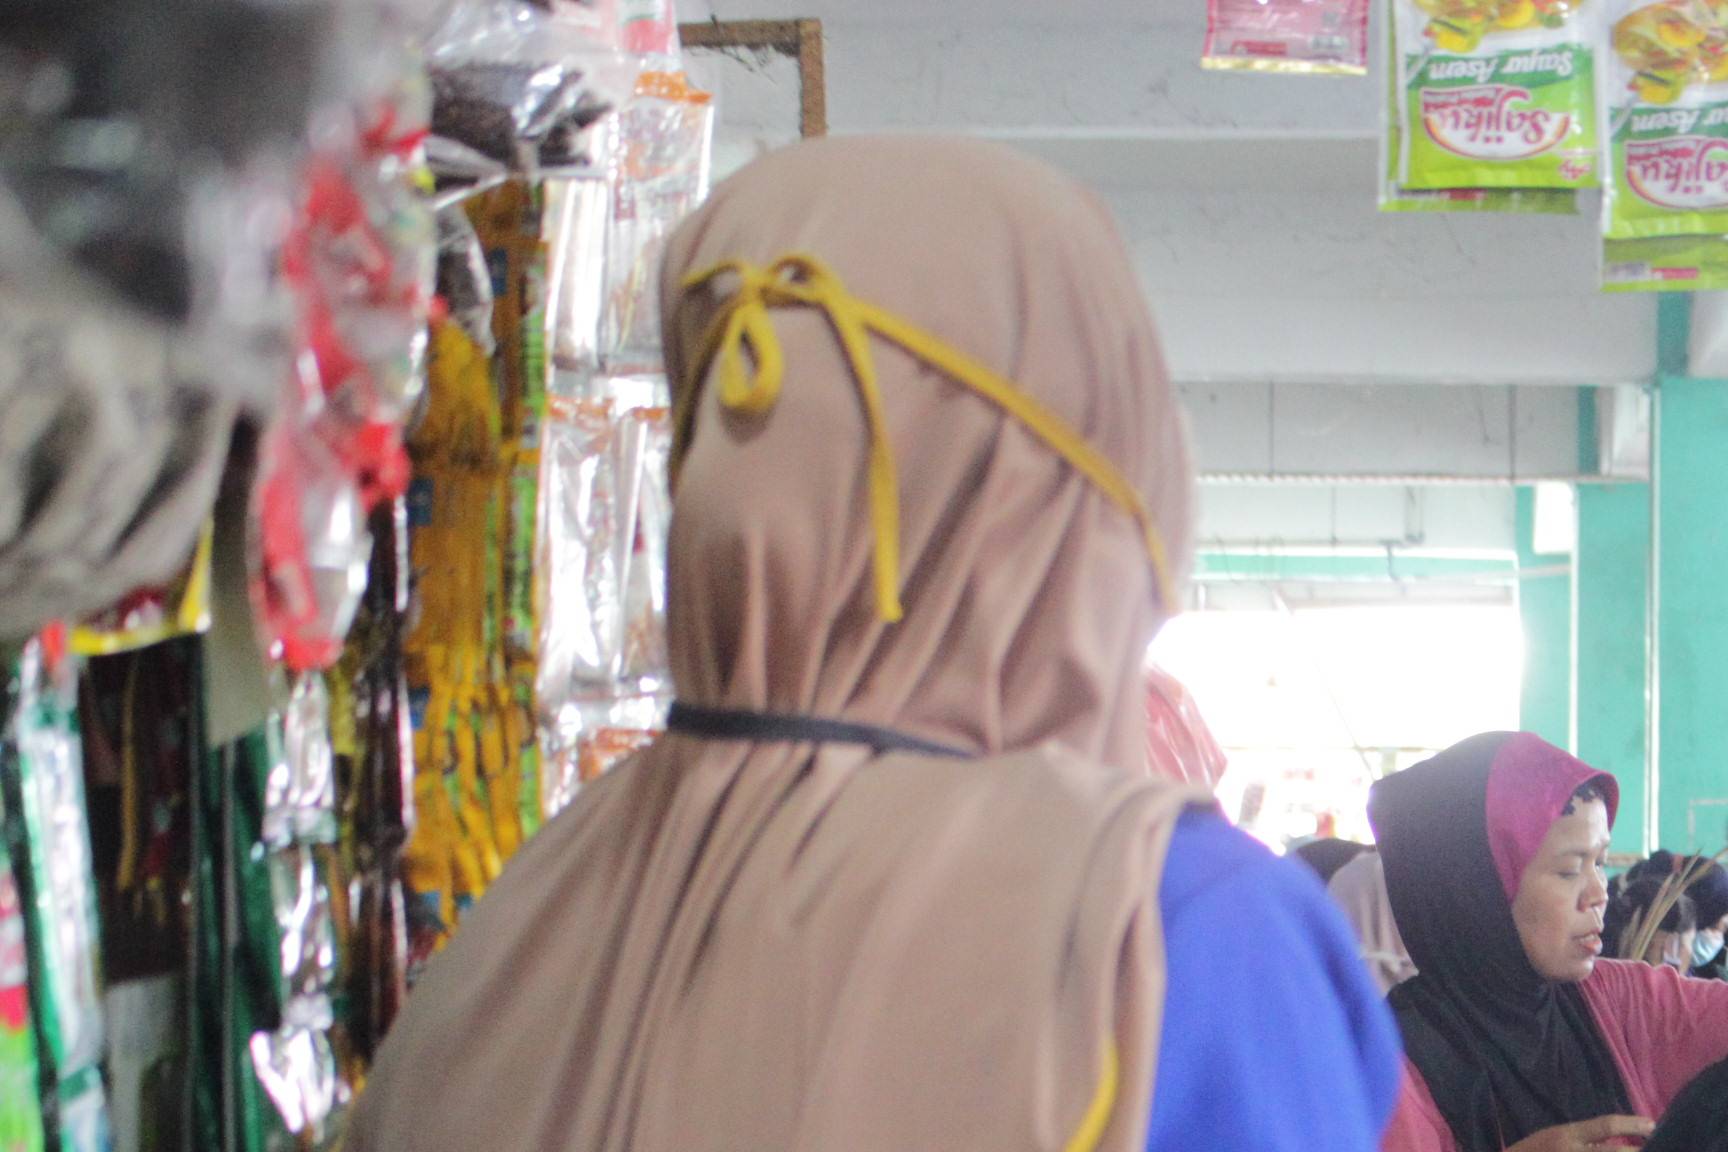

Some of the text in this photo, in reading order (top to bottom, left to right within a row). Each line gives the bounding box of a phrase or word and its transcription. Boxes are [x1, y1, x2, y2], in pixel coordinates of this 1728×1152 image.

[1429, 49, 1574, 83] Sayur Asem
[1438, 89, 1550, 145] Sajiku
[1631, 110, 1699, 133] Asem
